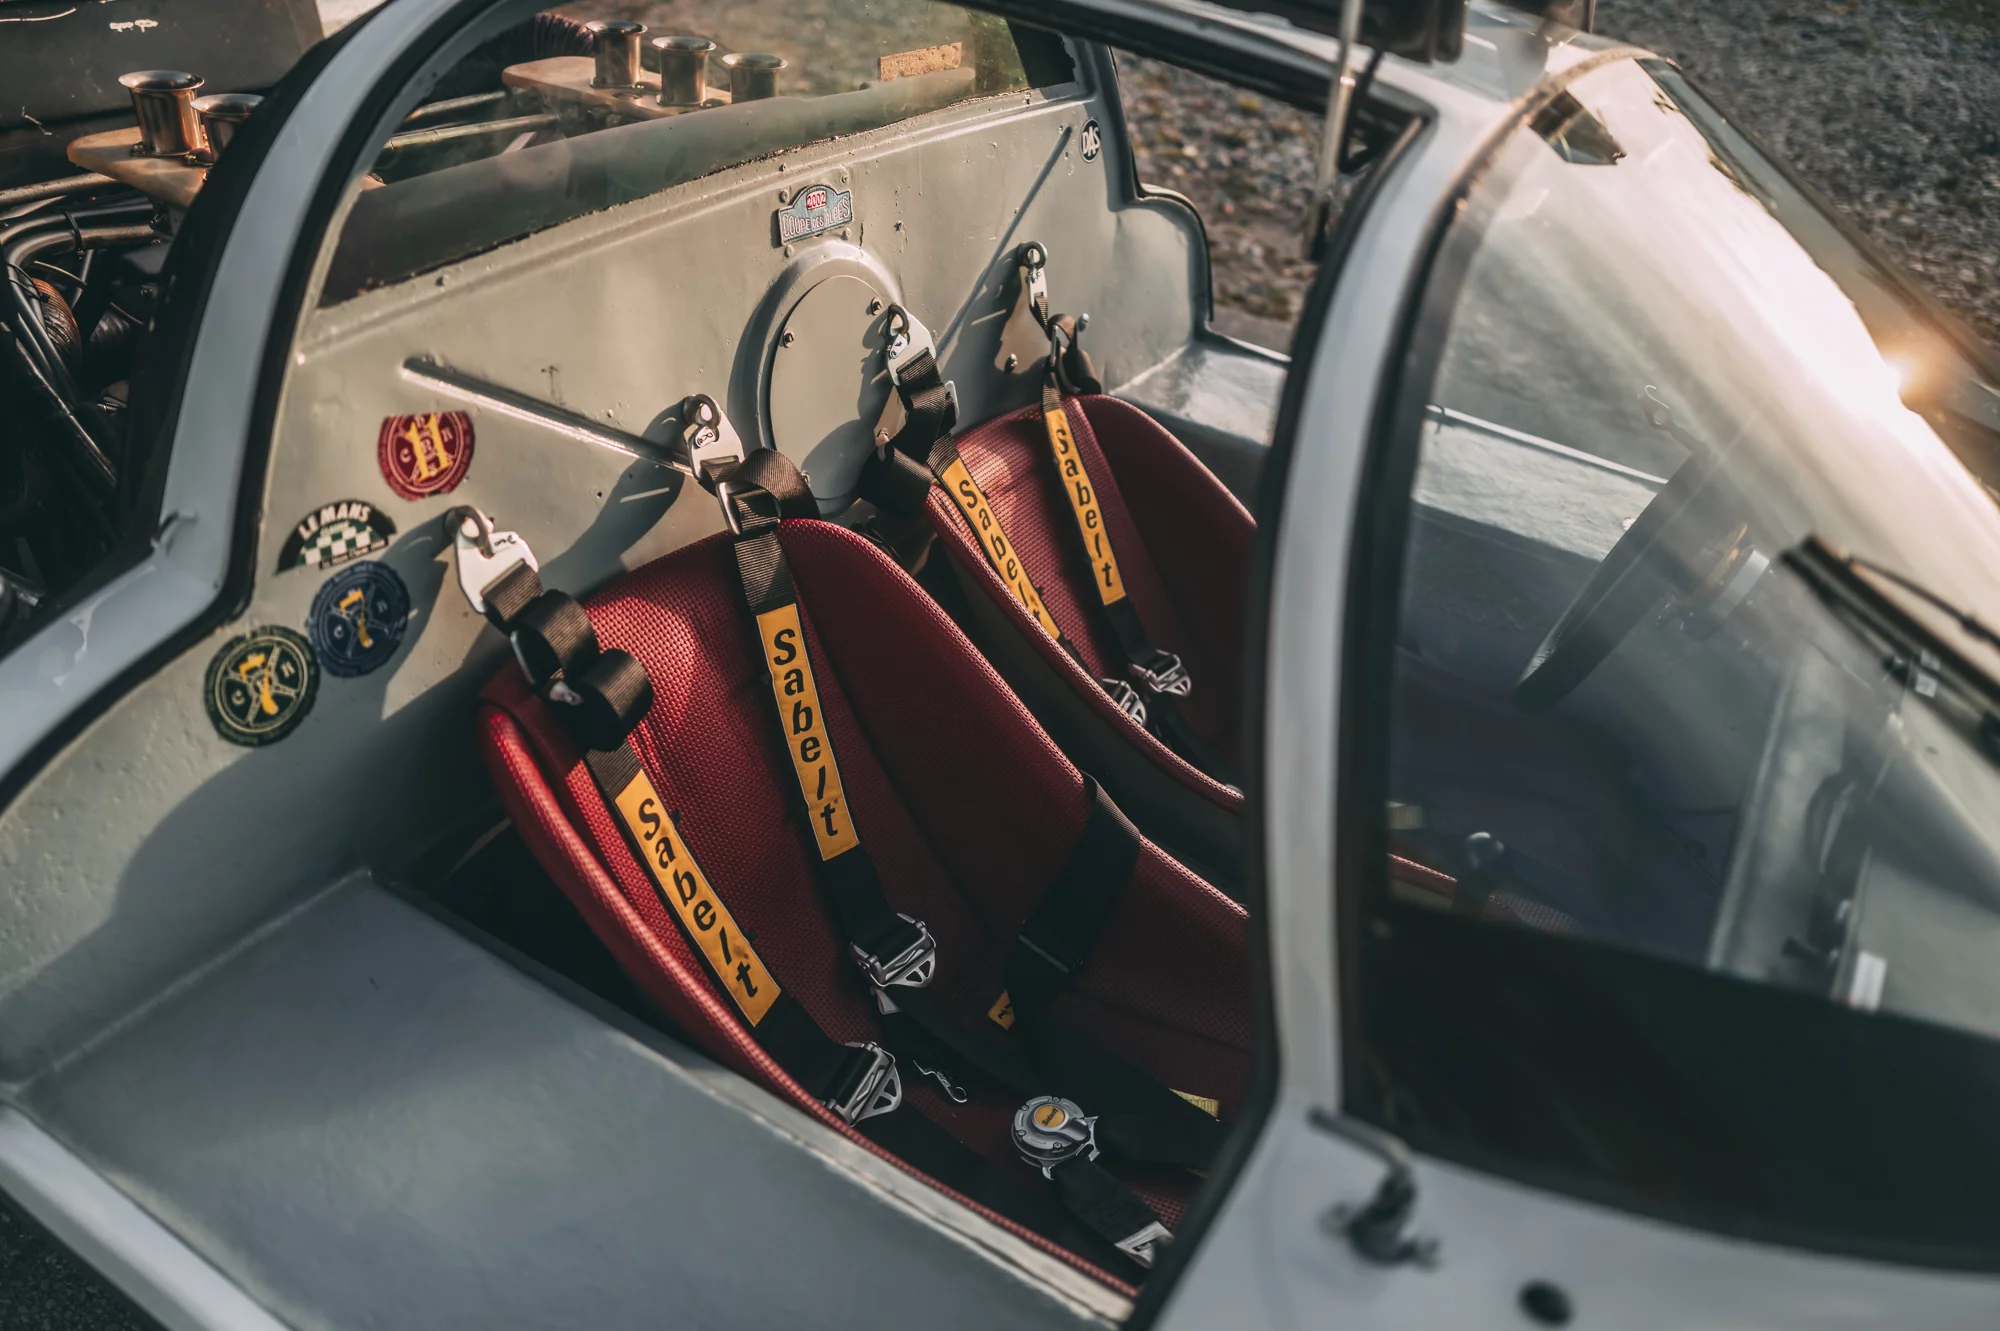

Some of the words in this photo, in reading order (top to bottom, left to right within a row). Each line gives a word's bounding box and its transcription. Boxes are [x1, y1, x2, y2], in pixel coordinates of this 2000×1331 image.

[1082, 126, 1100, 157] DAS
[782, 213, 811, 238] COUPE
[812, 216, 824, 230] DES
[825, 195, 850, 227] ALPES
[806, 192, 826, 210] 2002
[320, 502, 372, 525] MANS
[1056, 428, 1112, 588] Sabelt
[773, 628, 838, 837] Sabelt
[639, 797, 758, 998] Sabelt
